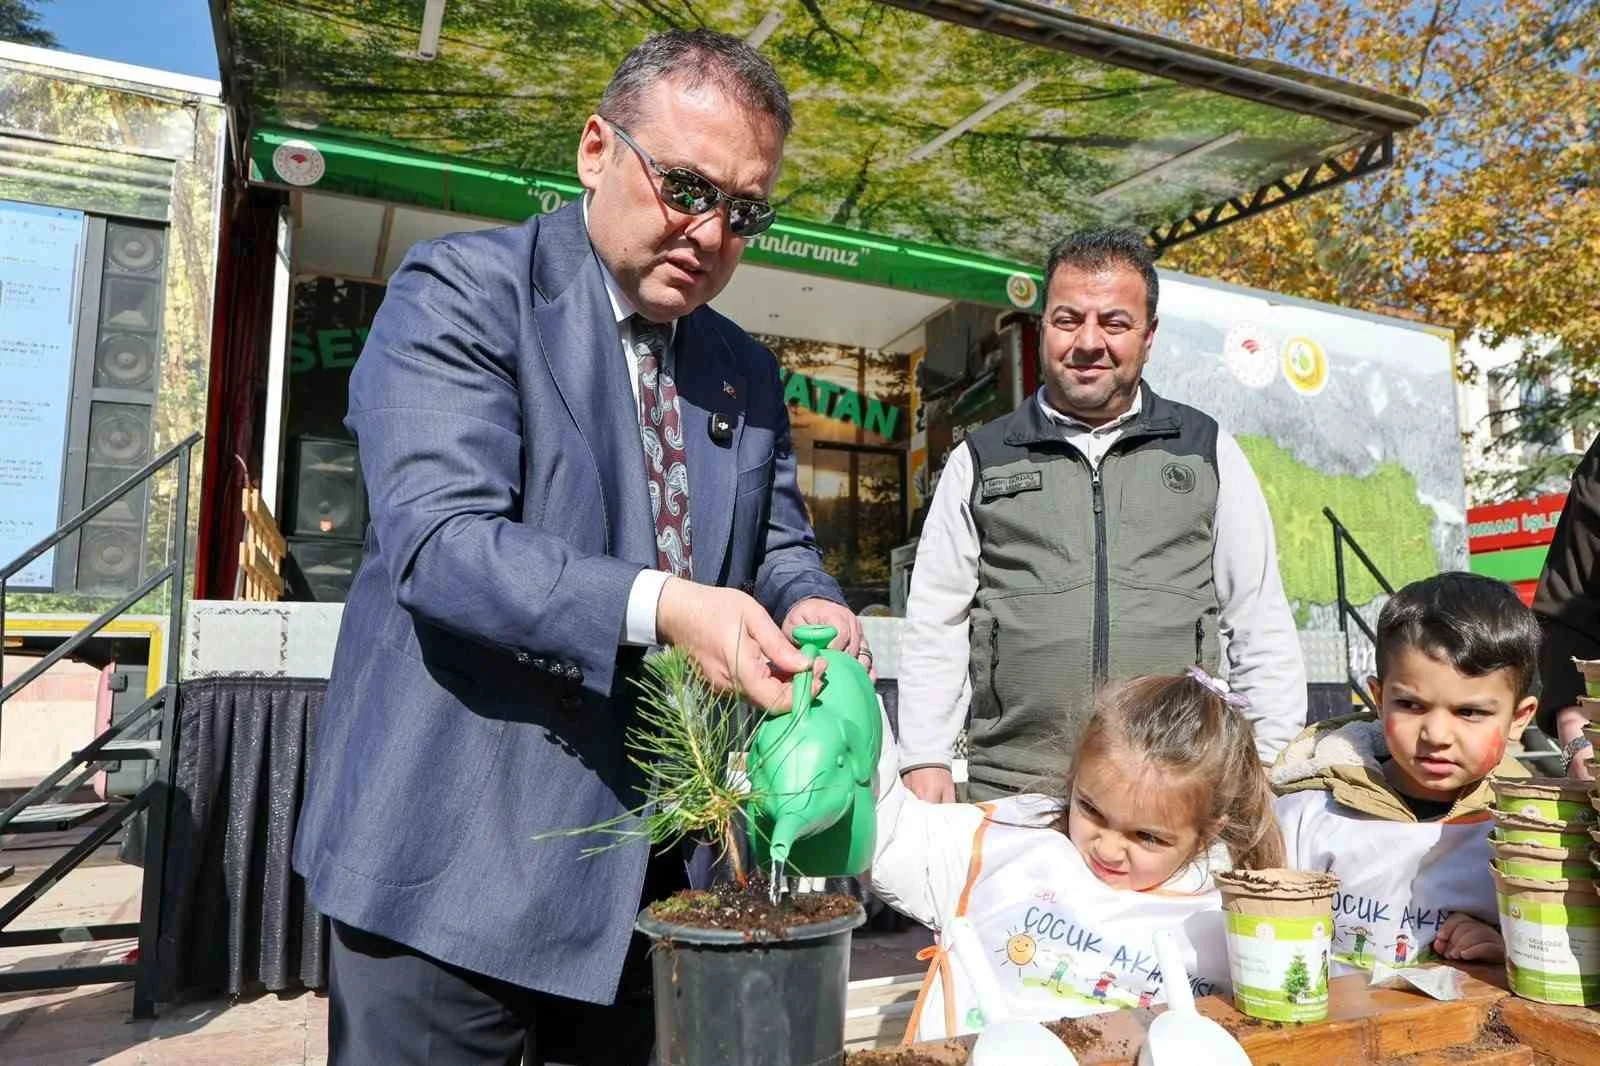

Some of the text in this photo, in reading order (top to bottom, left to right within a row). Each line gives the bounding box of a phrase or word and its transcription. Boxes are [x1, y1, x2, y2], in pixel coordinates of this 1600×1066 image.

[779, 366, 899, 441] ATAN
[1467, 516, 1519, 539] RMAN
[1023, 905, 1103, 954] ÇOCUK
[1331, 891, 1451, 931] OCUK AKA
